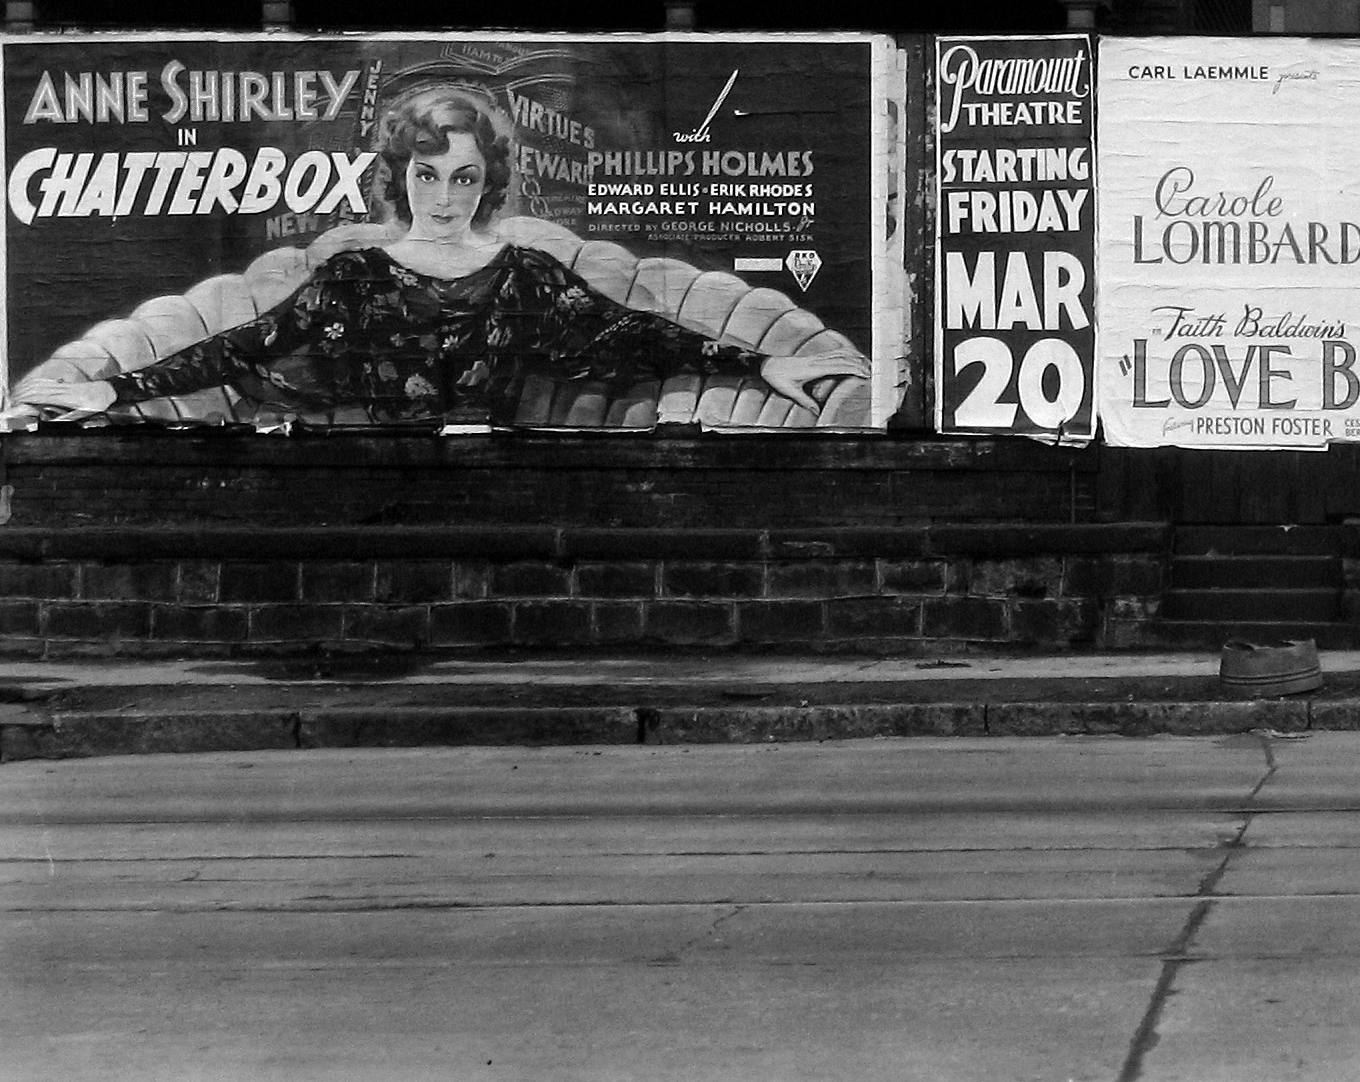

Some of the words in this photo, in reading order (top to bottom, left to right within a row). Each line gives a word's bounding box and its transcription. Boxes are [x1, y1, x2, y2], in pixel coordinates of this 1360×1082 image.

[23, 70, 149, 124] ANNE
[161, 59, 361, 124] SHIRLEY
[941, 45, 1089, 133] Paramount
[1128, 66, 1176, 79] CARL
[1183, 66, 1269, 80] LAEMMLE
[360, 60, 383, 137] JENNY
[962, 101, 1083, 126] THEATRE
[178, 128, 197, 146] IN
[506, 88, 595, 150] VIRTUES
[515, 143, 594, 186] EWARD
[587, 151, 695, 176] PHILLIPS
[702, 150, 814, 176] HOLMES
[943, 147, 1089, 184] STARTING
[8, 147, 379, 225] CHATTERBOX
[588, 183, 654, 196] EDWARD
[660, 183, 700, 196] ELLIS
[710, 183, 747, 197] ERIK
[749, 184, 813, 197] RHODES
[1155, 167, 1283, 220] Carole
[587, 202, 699, 215] MARGARET
[709, 202, 815, 216] HAMILTON
[588, 224, 641, 232] DIRECTED
[645, 224, 658, 232] BY
[661, 221, 715, 232] GEORGE
[720, 221, 791, 232] NICHOLLS
[948, 189, 1089, 234] FRIDAY
[746, 234, 784, 242] ROBERT
[946, 251, 1090, 330] MAR
[1152, 306, 1227, 341] Faith
[1234, 303, 1347, 339] Baldwin's
[954, 336, 1085, 430] 20
[1119, 339, 1297, 410] "LOVE
[1197, 418, 1264, 435] PRESTON
[1272, 418, 1334, 437] FOSTER
